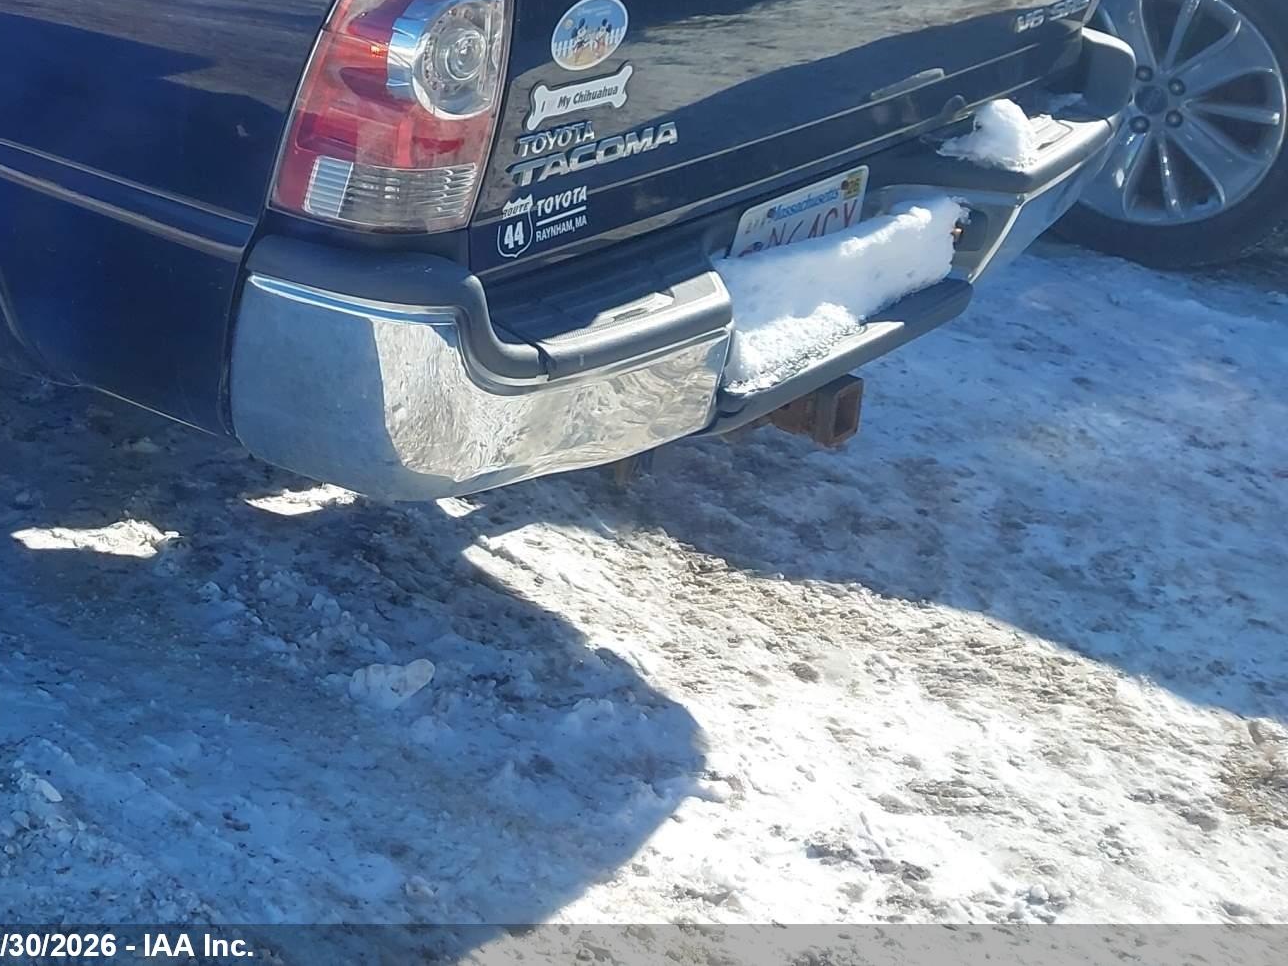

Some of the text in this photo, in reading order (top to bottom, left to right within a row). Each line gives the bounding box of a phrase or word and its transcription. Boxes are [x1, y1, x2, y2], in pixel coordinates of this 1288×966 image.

[557, 94, 571, 110] My
[573, 84, 619, 105] Chihuahua
[518, 121, 595, 157] TOYOTA
[511, 122, 679, 187] TACOMA
[503, 201, 530, 218] ROUTE
[537, 186, 588, 217] TOYOTA
[504, 221, 525, 249] 44
